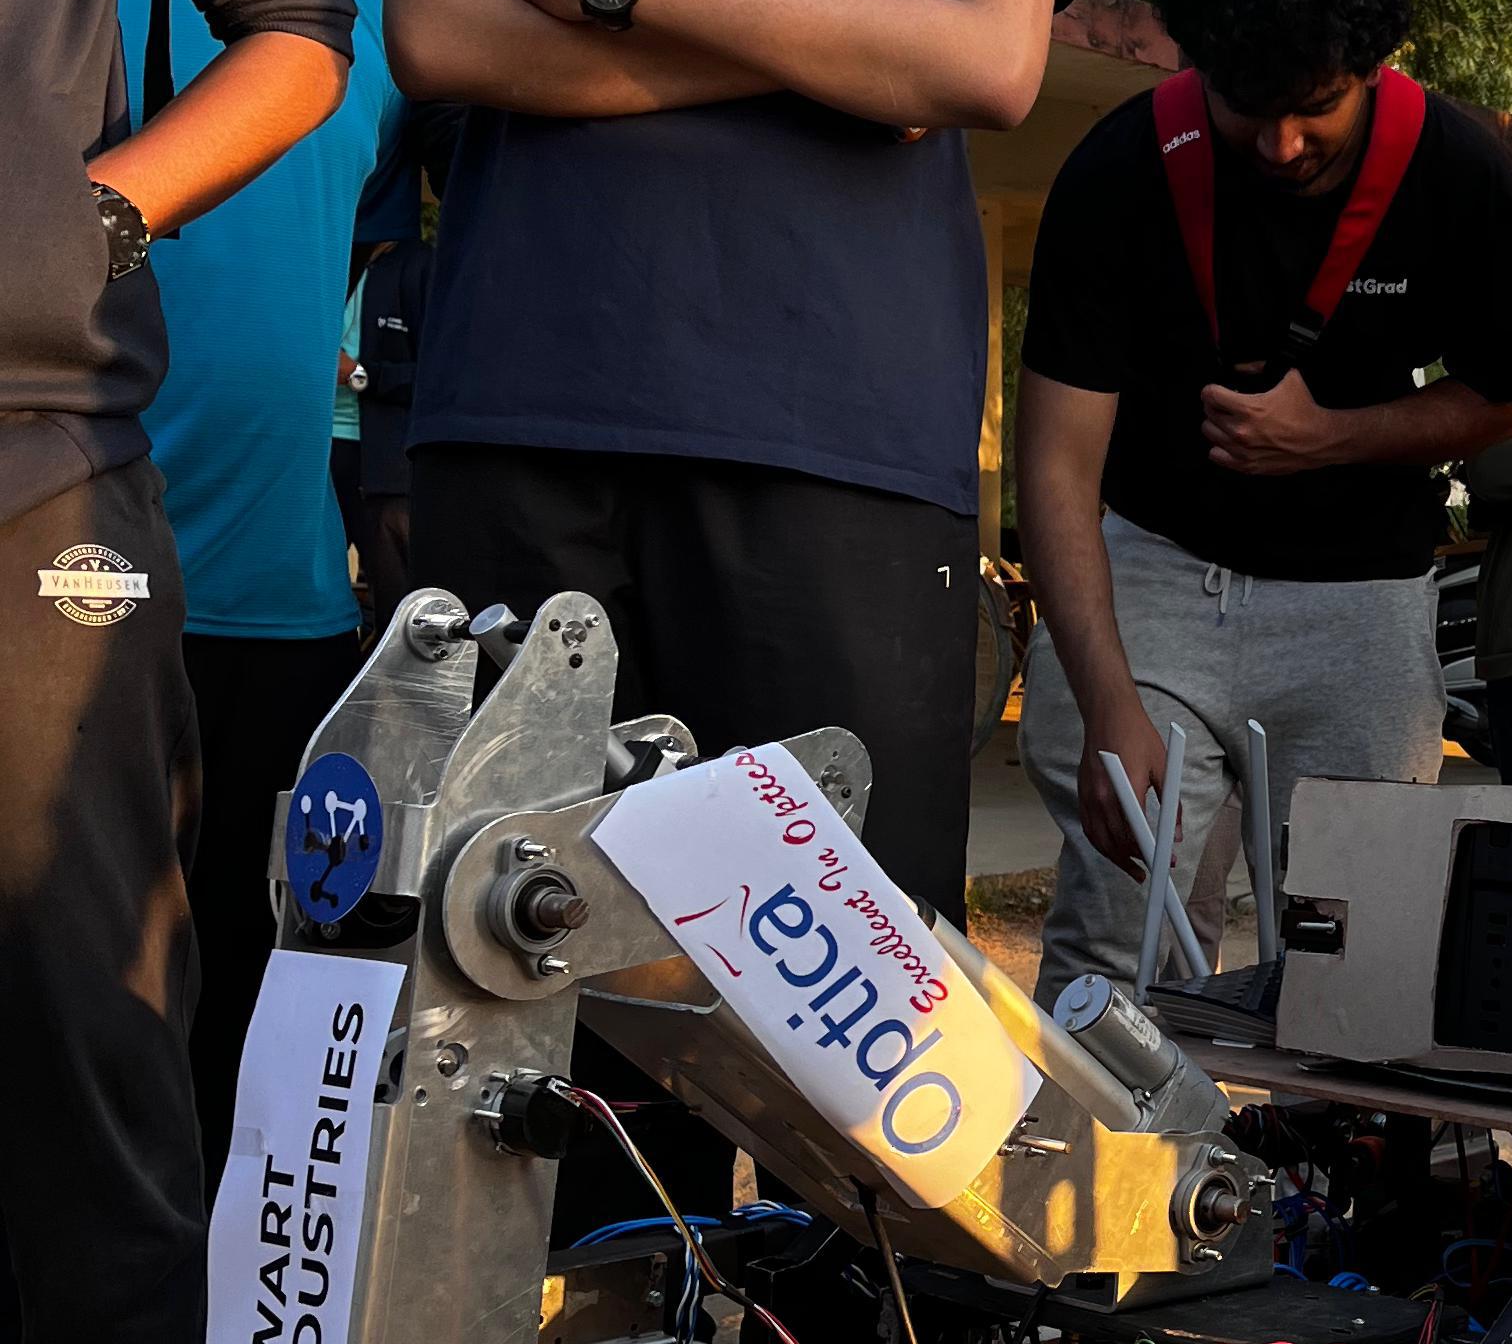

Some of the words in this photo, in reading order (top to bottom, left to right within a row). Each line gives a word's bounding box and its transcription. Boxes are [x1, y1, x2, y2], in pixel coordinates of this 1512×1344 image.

[1162, 129, 1201, 155] adidas
[843, 889, 949, 1014] Excellent
[748, 882, 963, 1156] Optica
